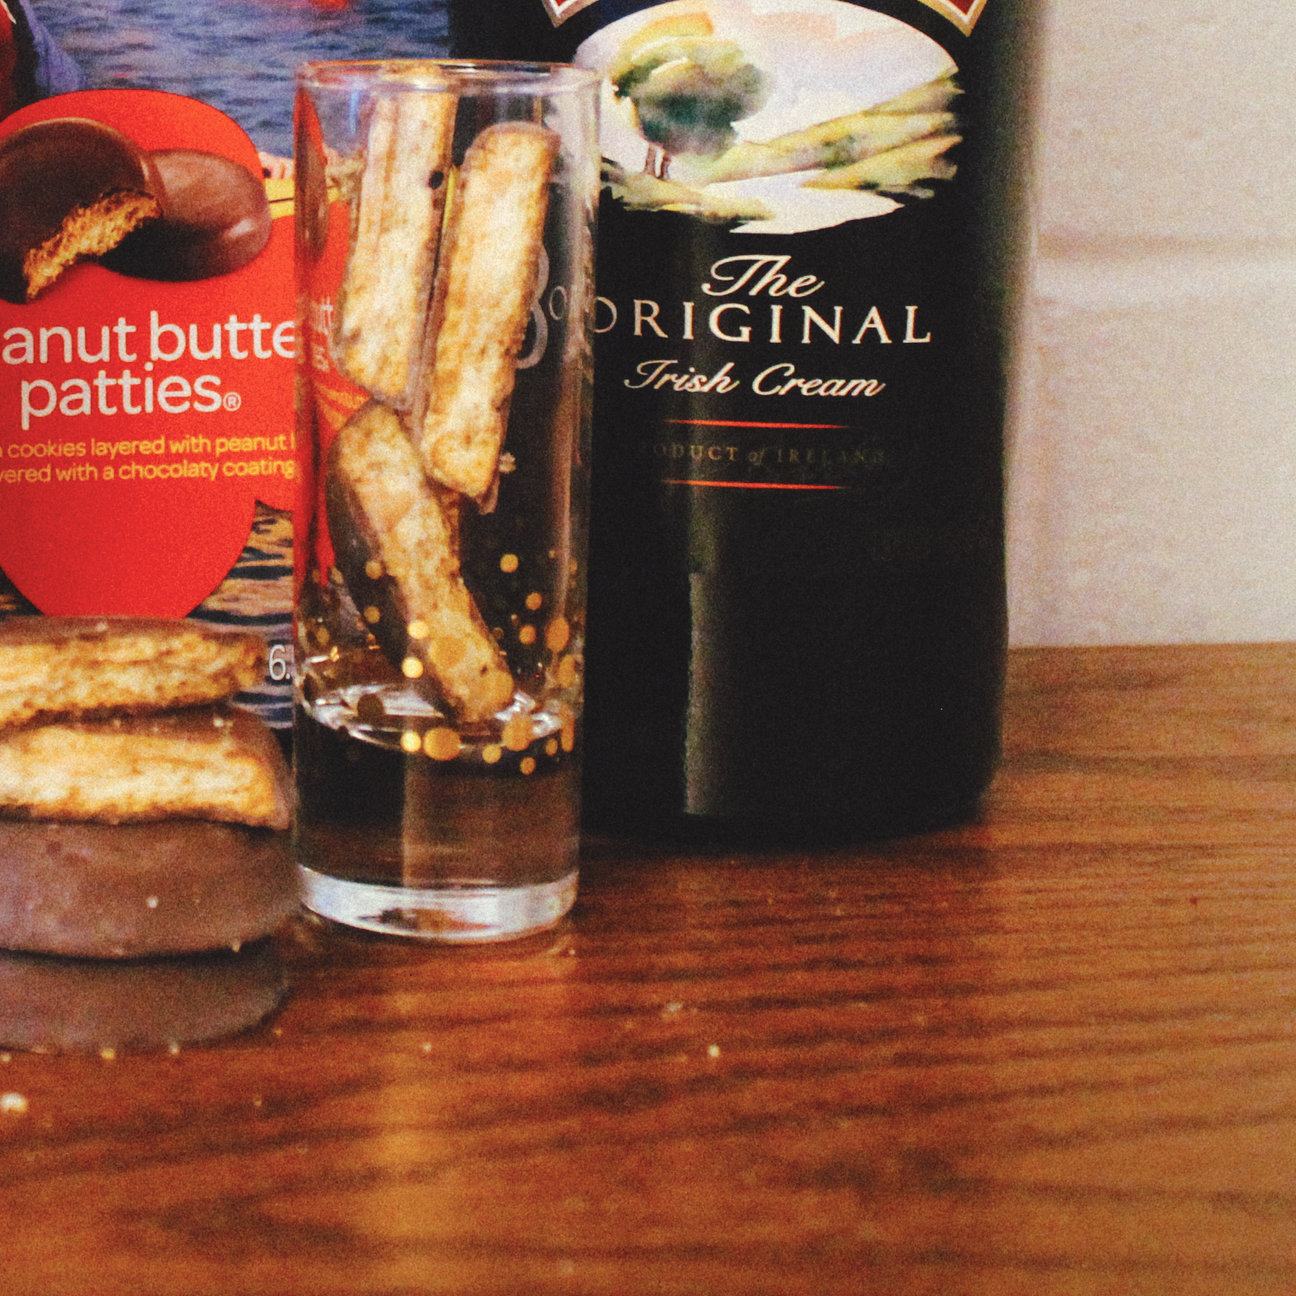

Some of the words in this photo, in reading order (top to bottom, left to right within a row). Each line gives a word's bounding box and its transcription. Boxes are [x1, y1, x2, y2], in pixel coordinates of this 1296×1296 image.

[702, 254, 824, 297] The
[150, 310, 296, 361] butte
[624, 359, 740, 394] Irish
[752, 362, 885, 396] Cream
[8, 438, 86, 458] cookies
[91, 436, 165, 458] layered
[170, 434, 211, 453] with
[215, 433, 287, 456] peanut
[56, 461, 98, 481] with
[103, 466, 115, 480] a
[118, 460, 219, 481] chocolaty
